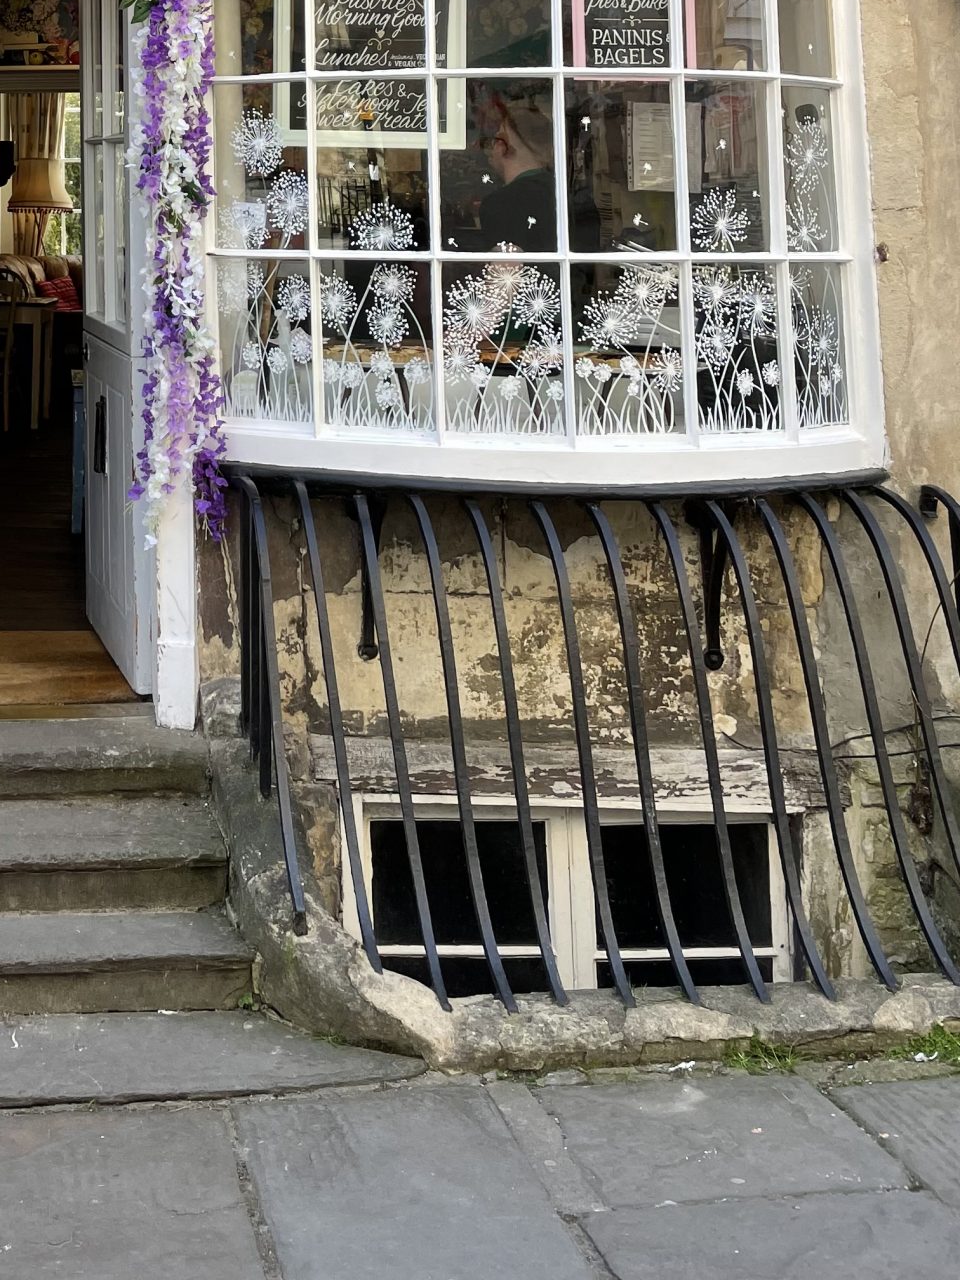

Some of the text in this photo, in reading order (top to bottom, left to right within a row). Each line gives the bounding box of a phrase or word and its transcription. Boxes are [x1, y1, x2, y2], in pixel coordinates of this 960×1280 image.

[315, 3, 441, 38] Morning Goos
[592, 28, 663, 46] PANINIS
[301, 38, 389, 66] Lunches
[593, 48, 665, 65] BAGELS
[366, 111, 428, 130] Treats
